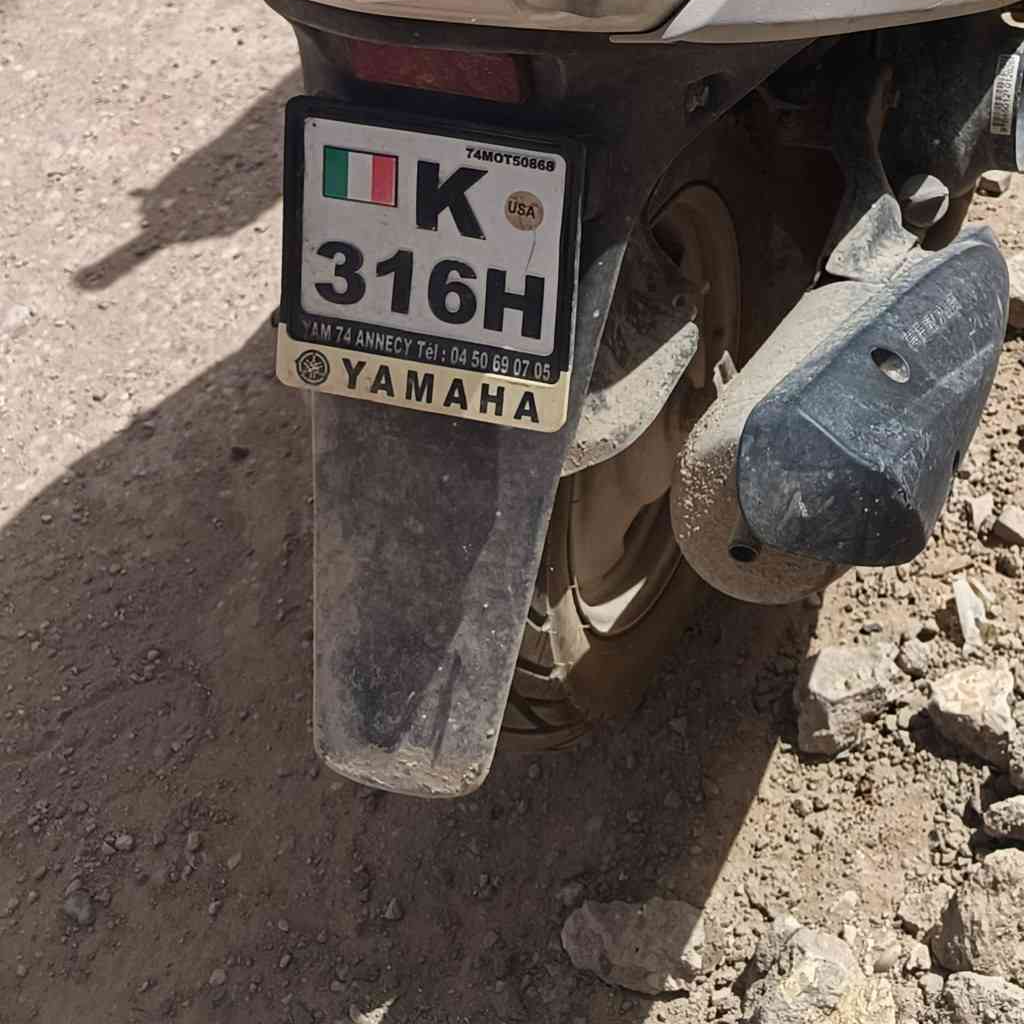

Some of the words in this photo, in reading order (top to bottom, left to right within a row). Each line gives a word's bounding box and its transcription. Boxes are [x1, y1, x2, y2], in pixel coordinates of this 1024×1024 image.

[465, 147, 556, 172] 74MOT50868
[416, 160, 488, 240] K
[508, 201, 536, 219] USA
[314, 241, 545, 340] 316H
[303, 319, 332, 341] YAM
[336, 326, 352, 345] 74
[355, 329, 413, 356] ANNECY
[416, 339, 439, 362] Tél
[450, 346, 468, 366] 04
[471, 350, 489, 369] 50
[492, 354, 509, 374] 69
[513, 358, 531, 377] 07
[534, 362, 551, 382] 05
[341, 357, 540, 424] YAMAHA
